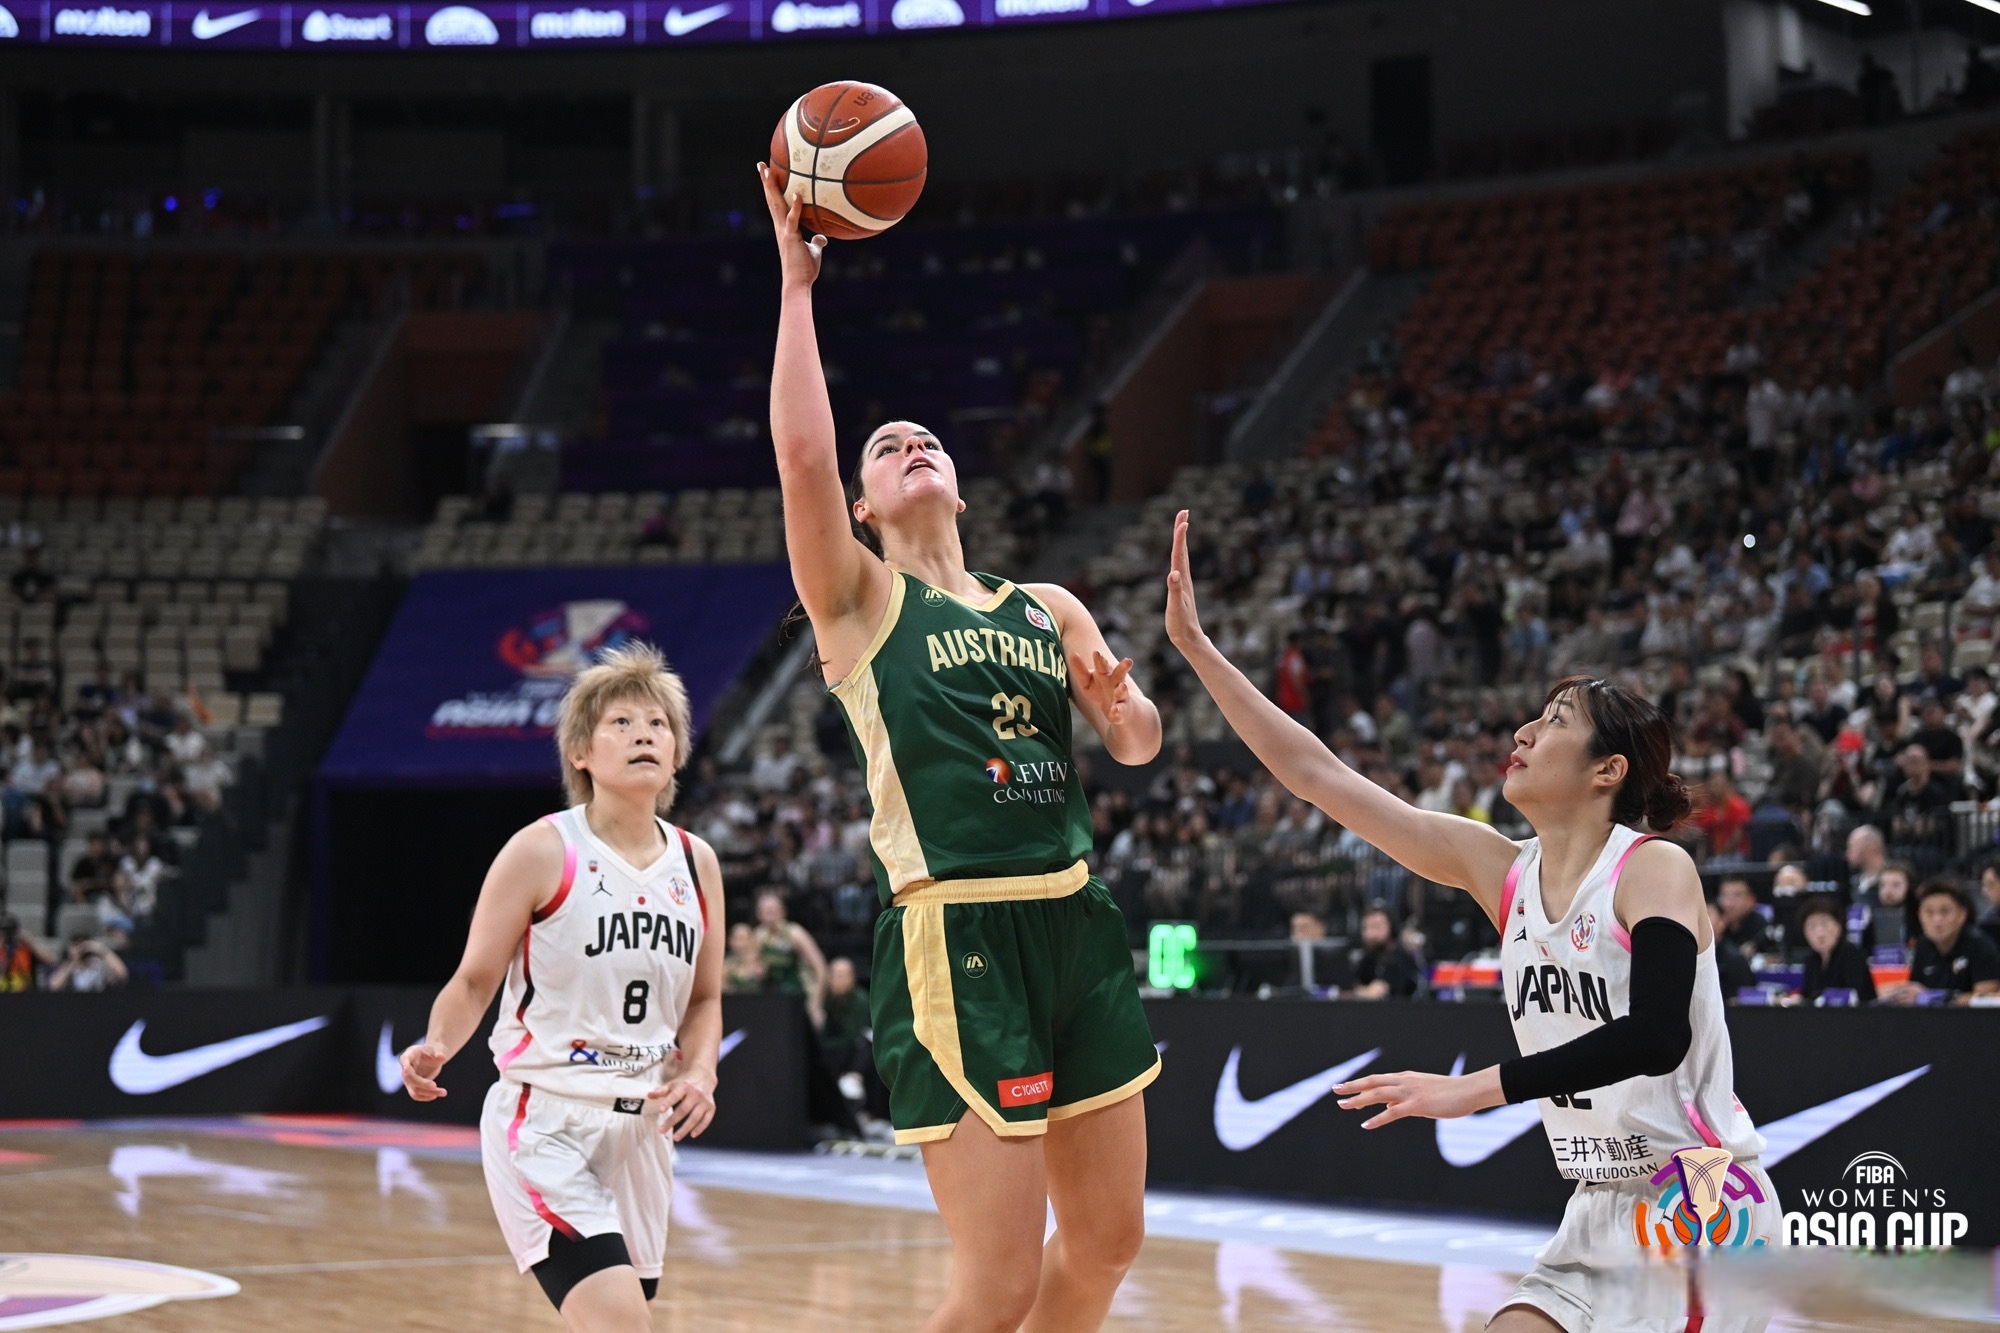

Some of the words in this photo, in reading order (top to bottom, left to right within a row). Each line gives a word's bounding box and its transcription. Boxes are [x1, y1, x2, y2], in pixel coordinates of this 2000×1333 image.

[926, 628, 1067, 688] AUSTRALIA
[585, 911, 695, 966] JAPAN
[623, 980, 649, 1024] 8
[1511, 965, 1614, 1025] JAPAN
[1011, 1080, 1049, 1098] CYGNETT
[1553, 1134, 1653, 1162] 三井不動産
[1597, 1162, 1660, 1180] FUDOSAN
